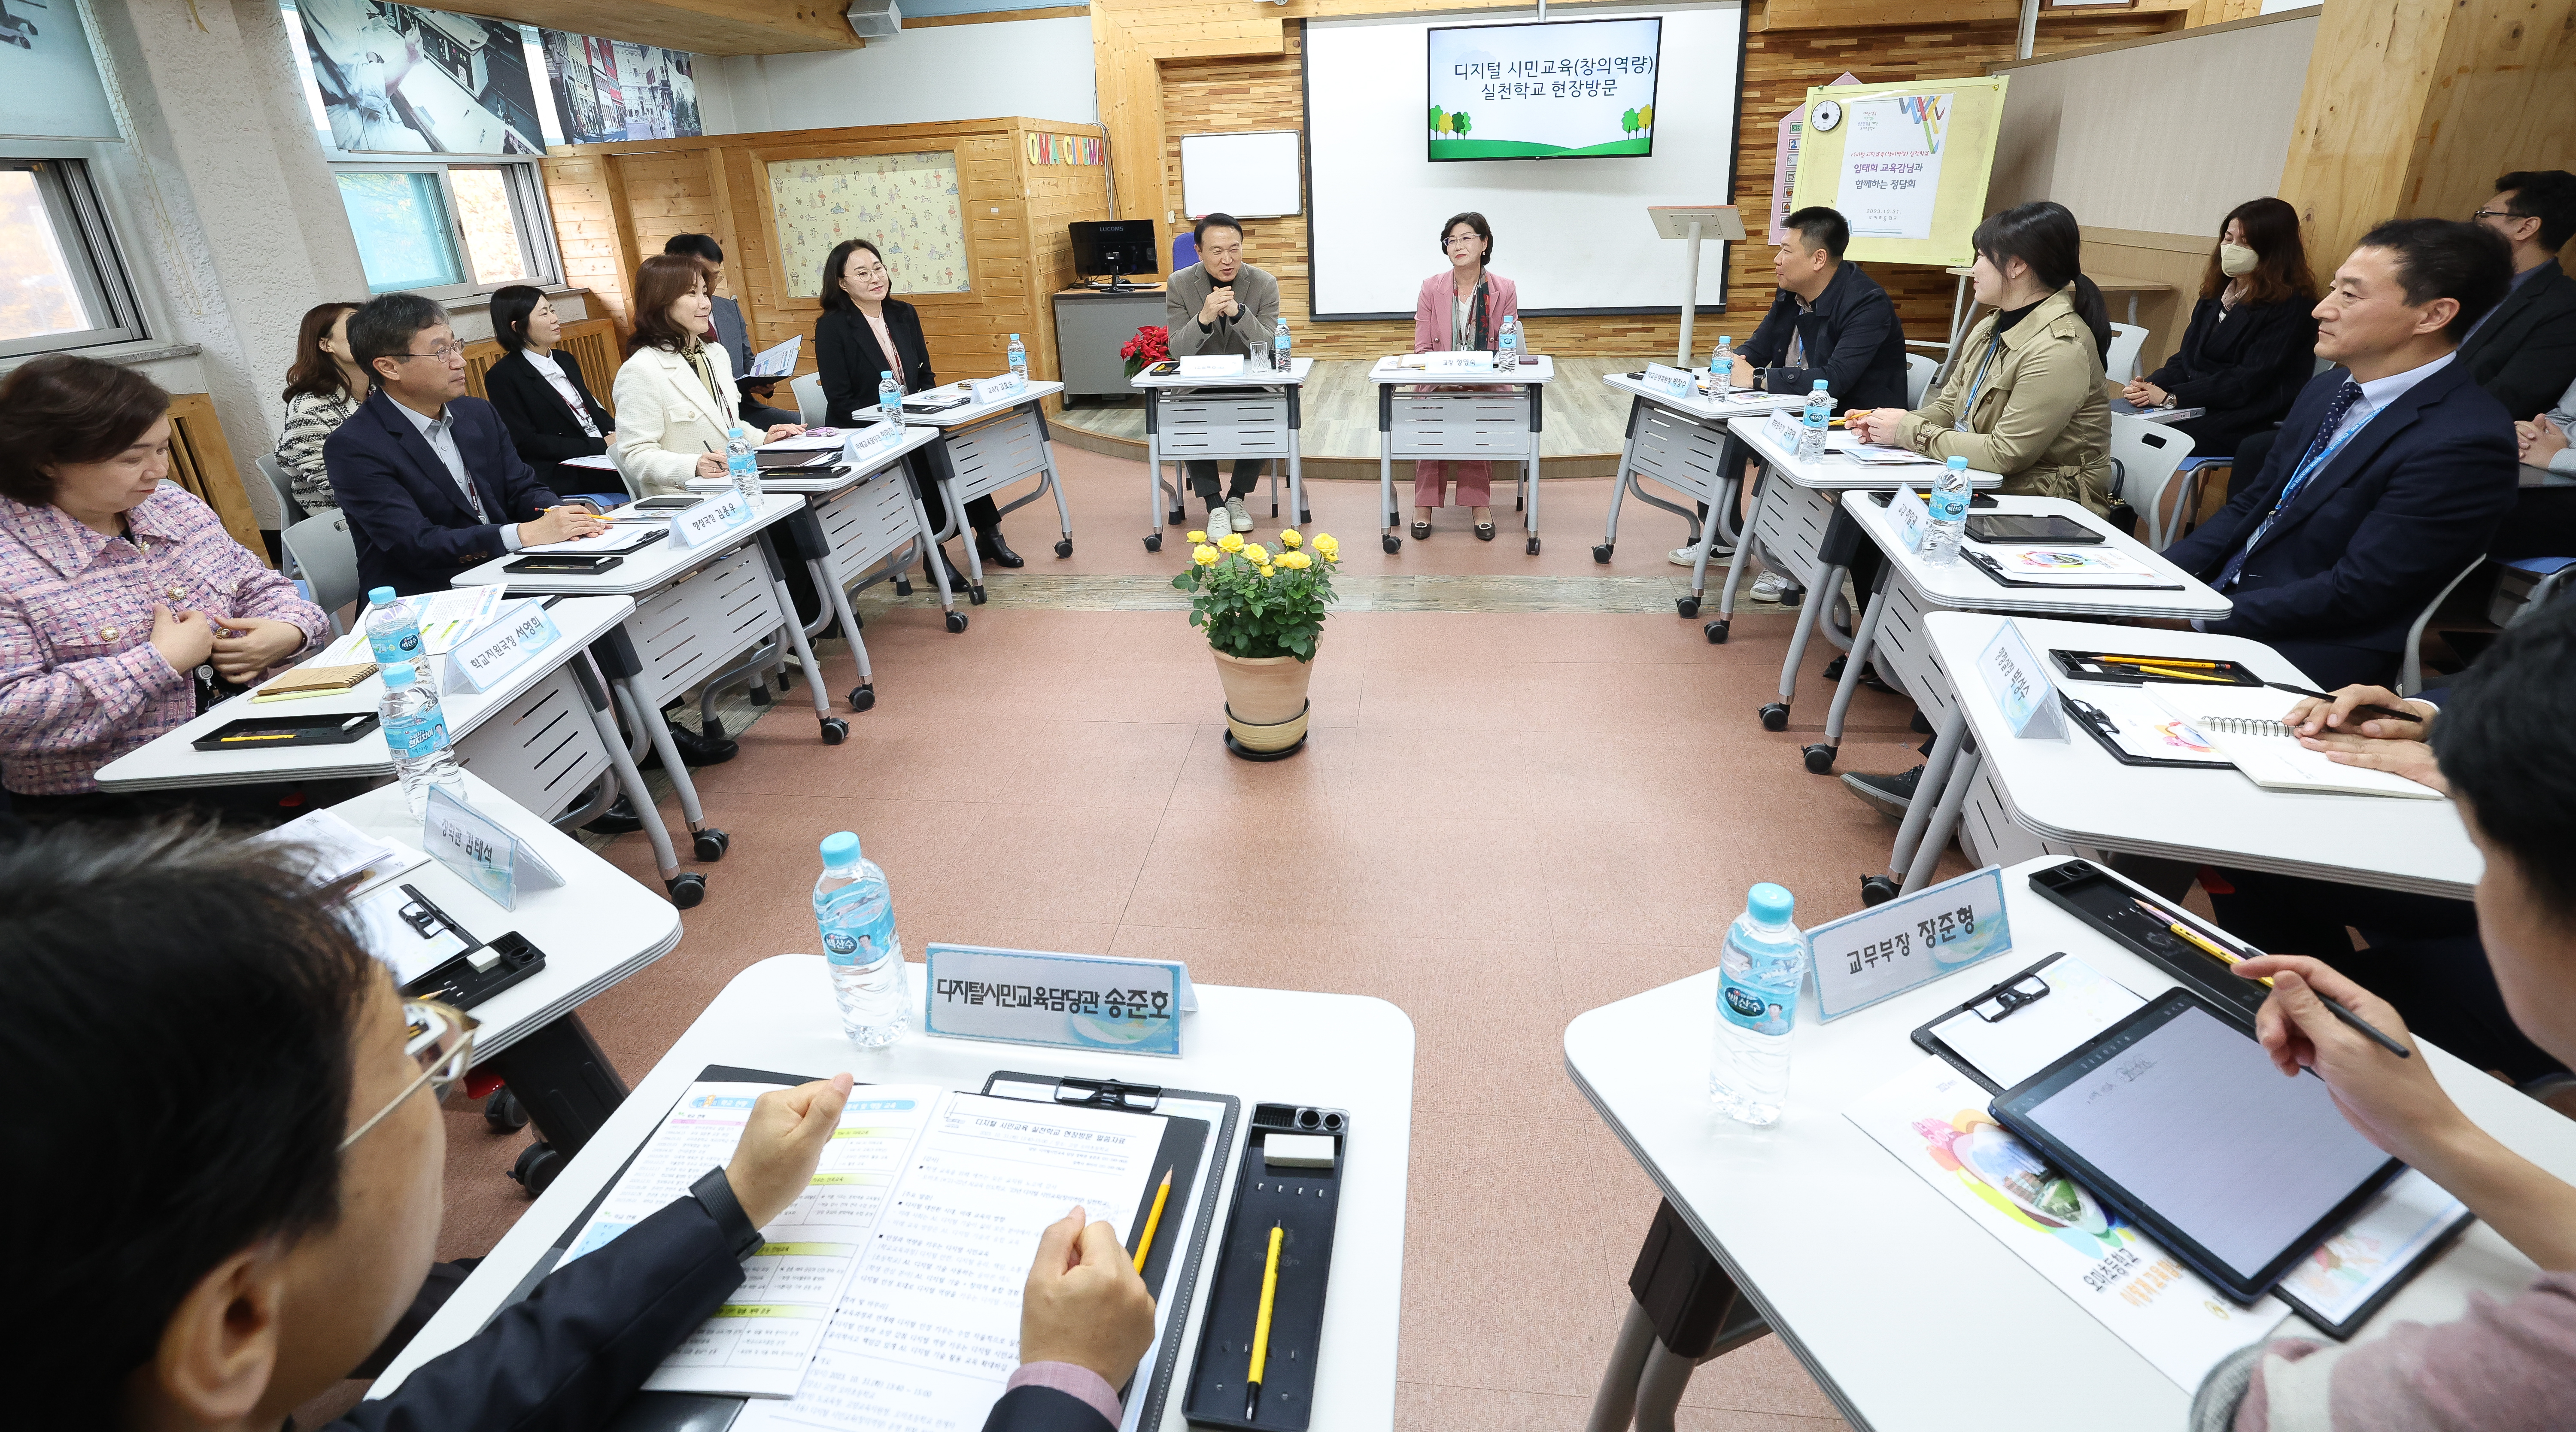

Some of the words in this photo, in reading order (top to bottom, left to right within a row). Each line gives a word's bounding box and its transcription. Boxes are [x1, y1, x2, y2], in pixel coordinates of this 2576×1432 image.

[1455, 61, 1501, 80] 디지털
[1507, 55, 1653, 78] 시민교육(창의역량)
[1481, 81, 1546, 100] 실천학교
[1552, 79, 1618, 98] 현장방문
[1027, 132, 1060, 165] OMA
[1063, 135, 1105, 165] CINEMA
[1854, 164, 1878, 173] 임태희
[1880, 163, 1923, 173] 교육감님과
[1856, 179, 1888, 189] 함께하는
[1890, 179, 1916, 190] 정담회
[1673, 377, 1686, 388] 박정수
[880, 427, 895, 438] 하미진
[692, 514, 716, 530] 행정국장
[715, 503, 735, 520] 김용우
[1898, 503, 1908, 516] 교감
[401, 638, 417, 648] 백산수
[470, 635, 517, 669] 학교지원국장
[516, 616, 543, 639] 서영희
[1995, 647, 2015, 677] 행정실장
[2011, 668, 2030, 701] 박성수
[442, 818, 462, 847] 장학관
[466, 830, 492, 868] 김태석
[826, 938, 854, 949] 백산수
[1846, 932, 1911, 975] 교무부장
[1917, 904, 1975, 949] 장준형
[937, 978, 1100, 1015] 디지털시민교육담당관
[1104, 987, 1170, 1020] 송준호
[1728, 991, 1761, 1012] 백산수
[975, 1119, 997, 1128] 디지털
[999, 1122, 1028, 1131] 시민교육
[1031, 1126, 1061, 1136] 실천학교
[1063, 1131, 1093, 1140] 현장방문
